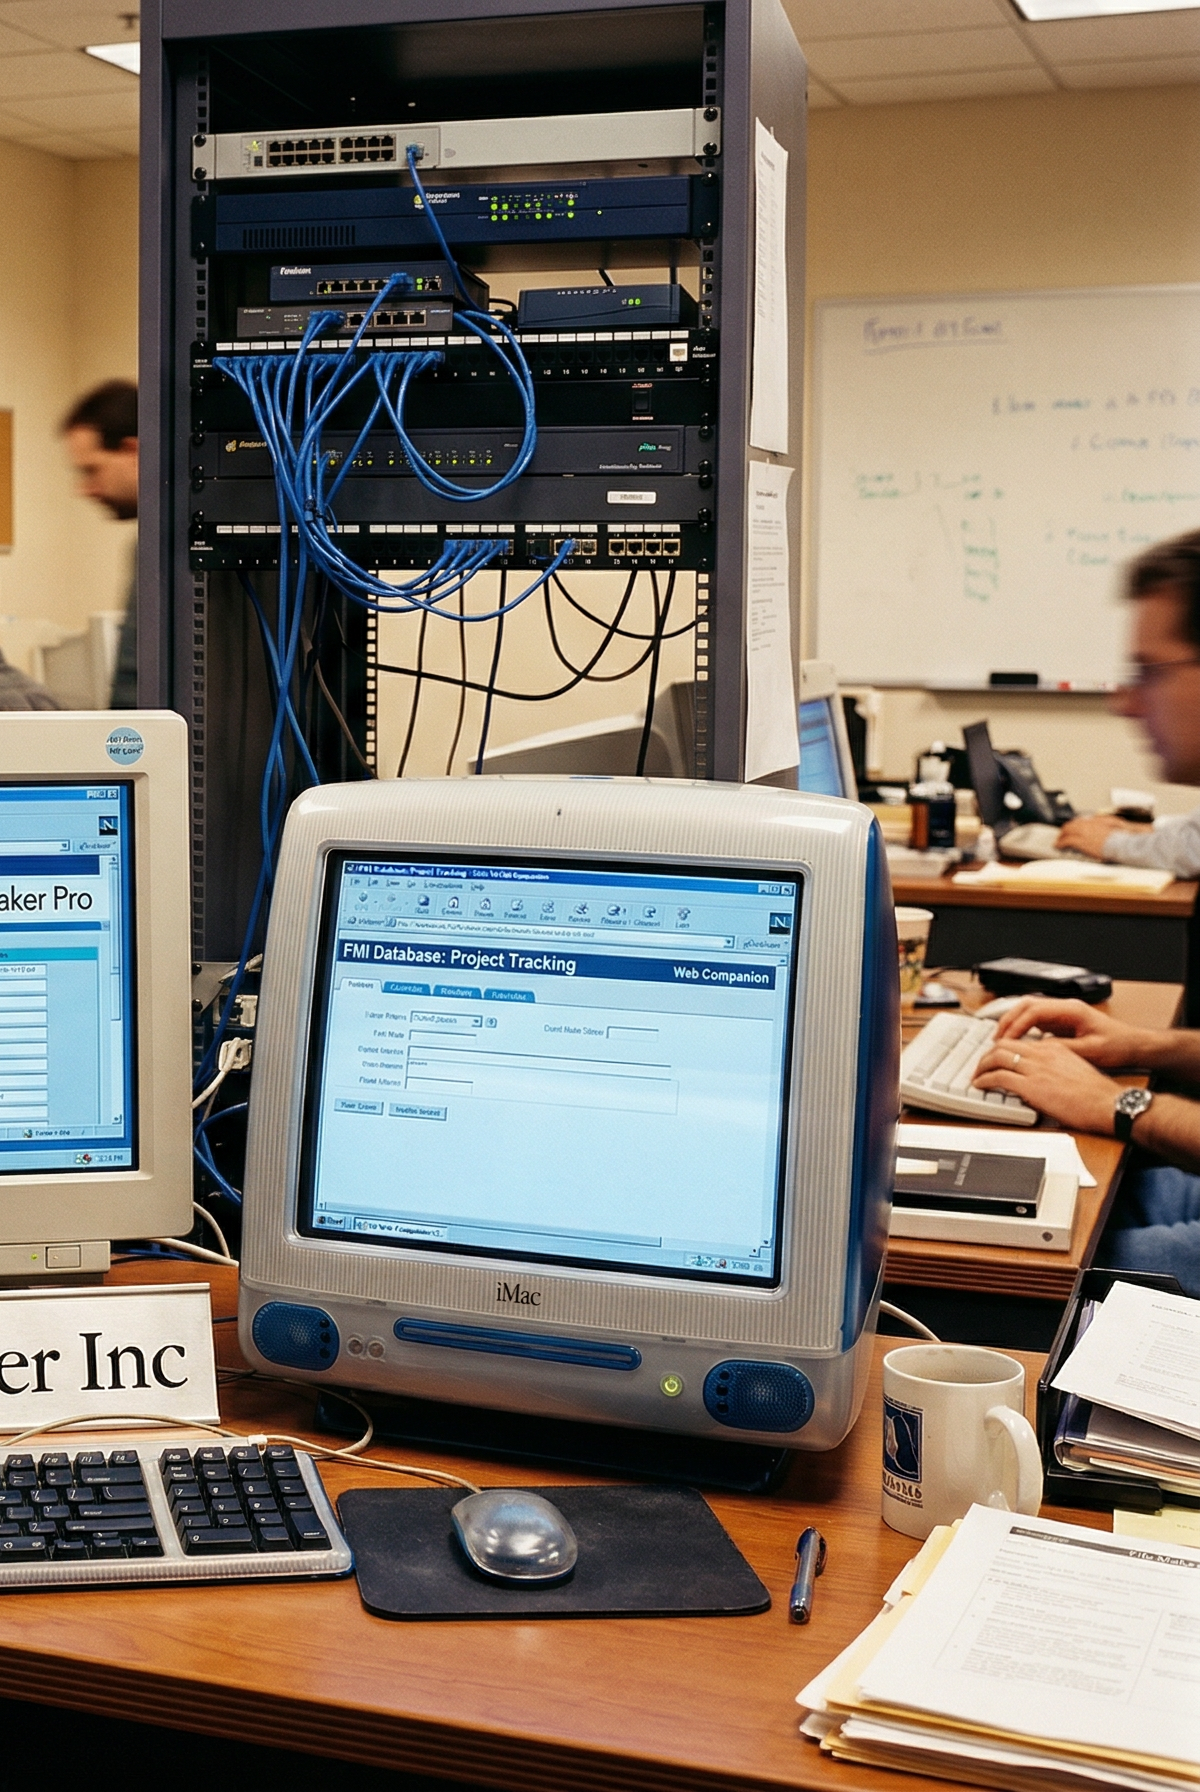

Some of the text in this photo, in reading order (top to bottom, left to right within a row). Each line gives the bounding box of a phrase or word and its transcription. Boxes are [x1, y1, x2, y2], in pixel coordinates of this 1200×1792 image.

[54, 886, 93, 910] Pro
[343, 943, 576, 976] FMI Database: Project Tracking
[674, 966, 769, 984] Web Companion
[496, 1282, 541, 1306] iMac
[78, 1332, 189, 1391] Inc
